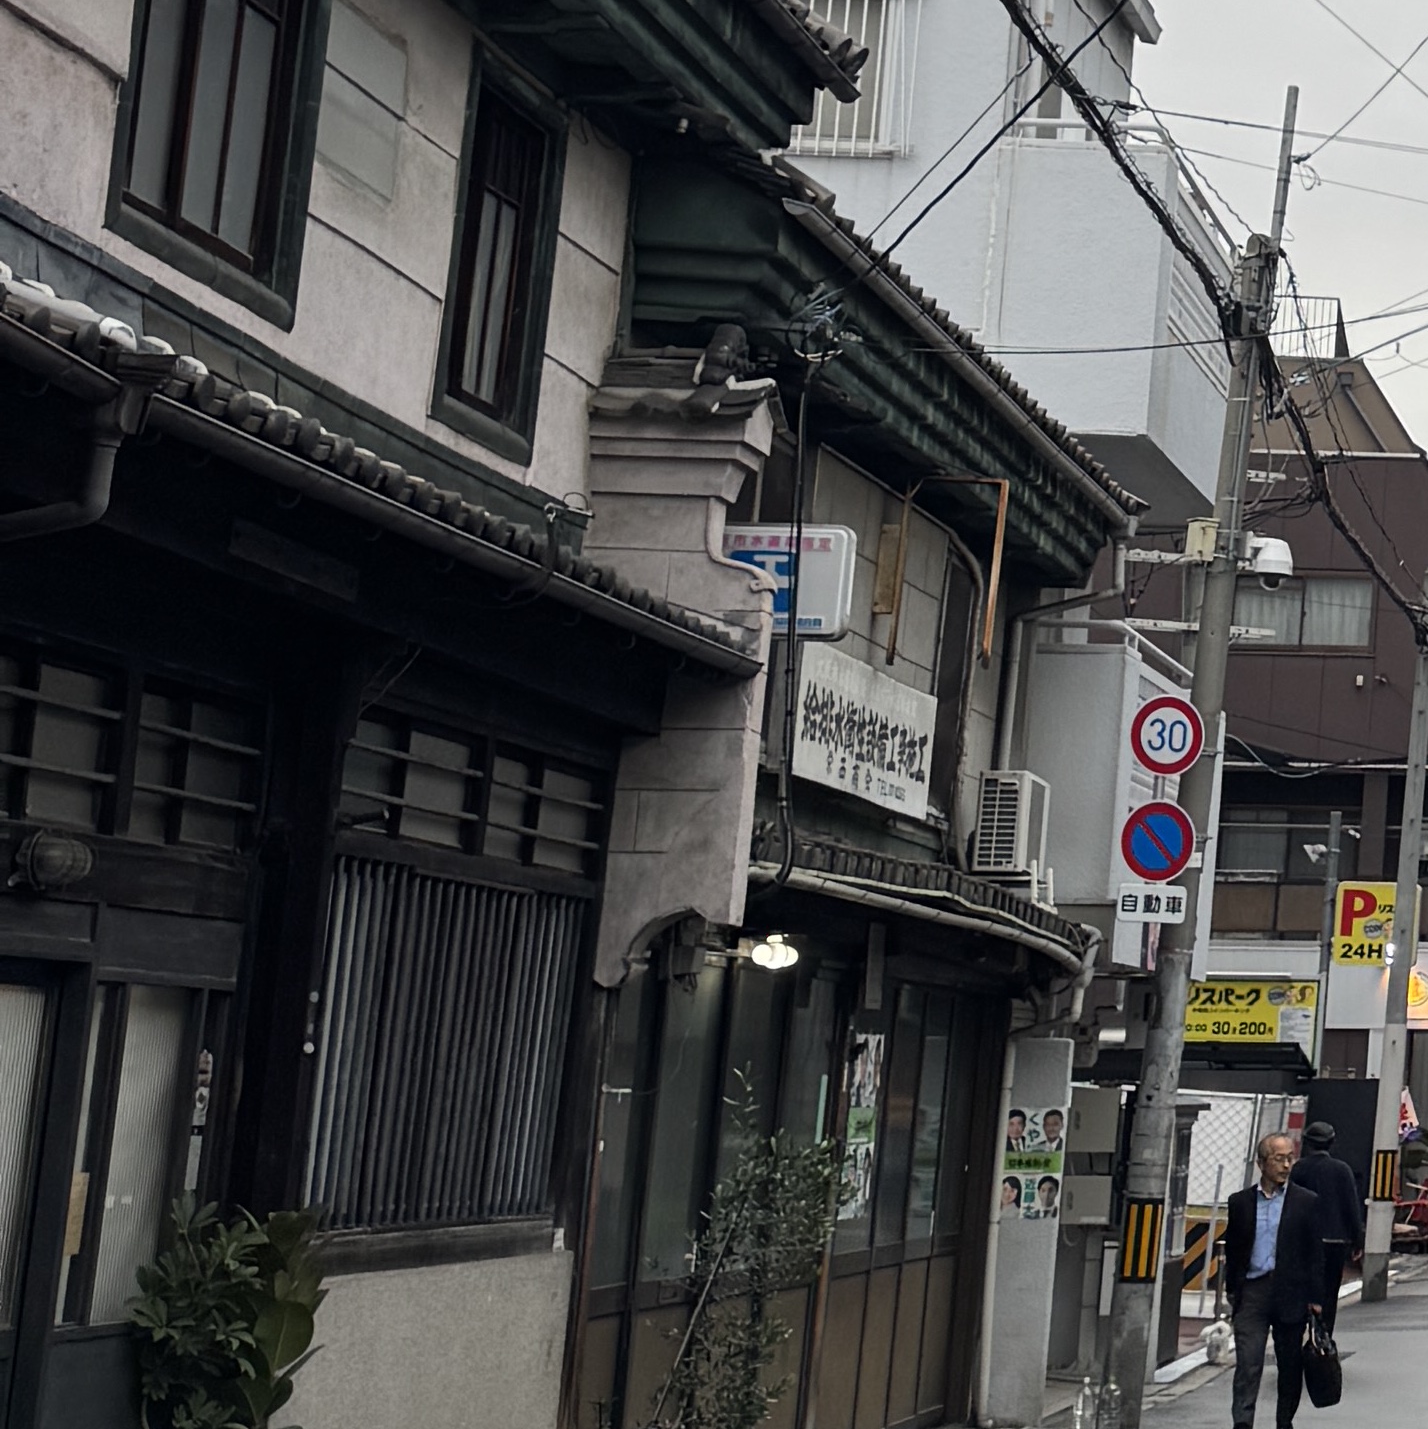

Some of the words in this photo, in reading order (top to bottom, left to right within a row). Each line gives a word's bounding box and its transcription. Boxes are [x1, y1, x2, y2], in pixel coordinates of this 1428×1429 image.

[1148, 719, 1187, 753] 30
[1122, 893, 1183, 914] 自動車
[1340, 889, 1377, 937] P
[1340, 943, 1383, 959] 24H
